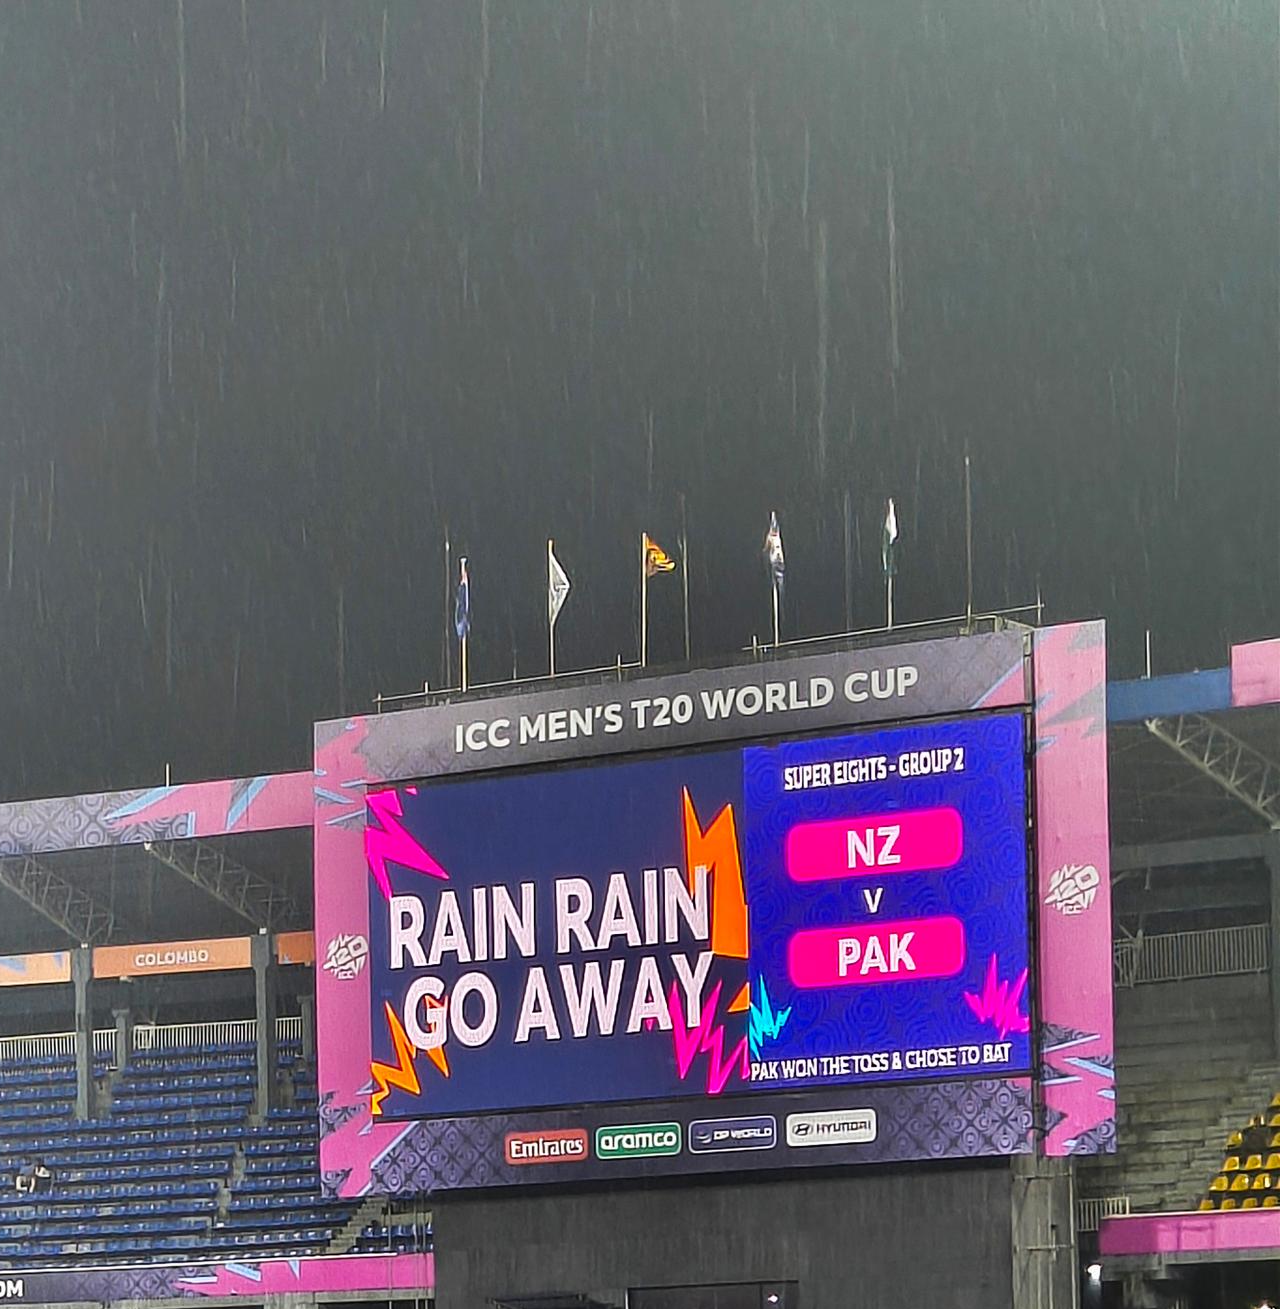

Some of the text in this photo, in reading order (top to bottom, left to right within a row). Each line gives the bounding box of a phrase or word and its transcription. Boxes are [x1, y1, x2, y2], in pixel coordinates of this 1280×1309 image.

[455, 665, 919, 752] ICC MEN'S T20 WORLD CUP
[784, 767, 831, 790] SUPER
[834, 756, 887, 785] EIGHTS
[899, 749, 951, 777] GROUP
[953, 748, 964, 771] 2
[847, 825, 901, 868] NZ
[390, 865, 709, 969] RAIN RAIN
[135, 949, 209, 966] COLOMBO
[838, 932, 916, 977] PAK
[404, 951, 714, 1050] GO AWAY
[751, 1062, 778, 1081] PAK
[781, 1060, 818, 1079] WON
[820, 1056, 850, 1075] THE
[850, 1053, 889, 1073] TOSS
[905, 1047, 956, 1069] CHOSE
[958, 1046, 980, 1064] TO
[983, 1043, 1012, 1063] BAT
[511, 1137, 583, 1158] Emirates
[601, 1131, 677, 1150] aramco
